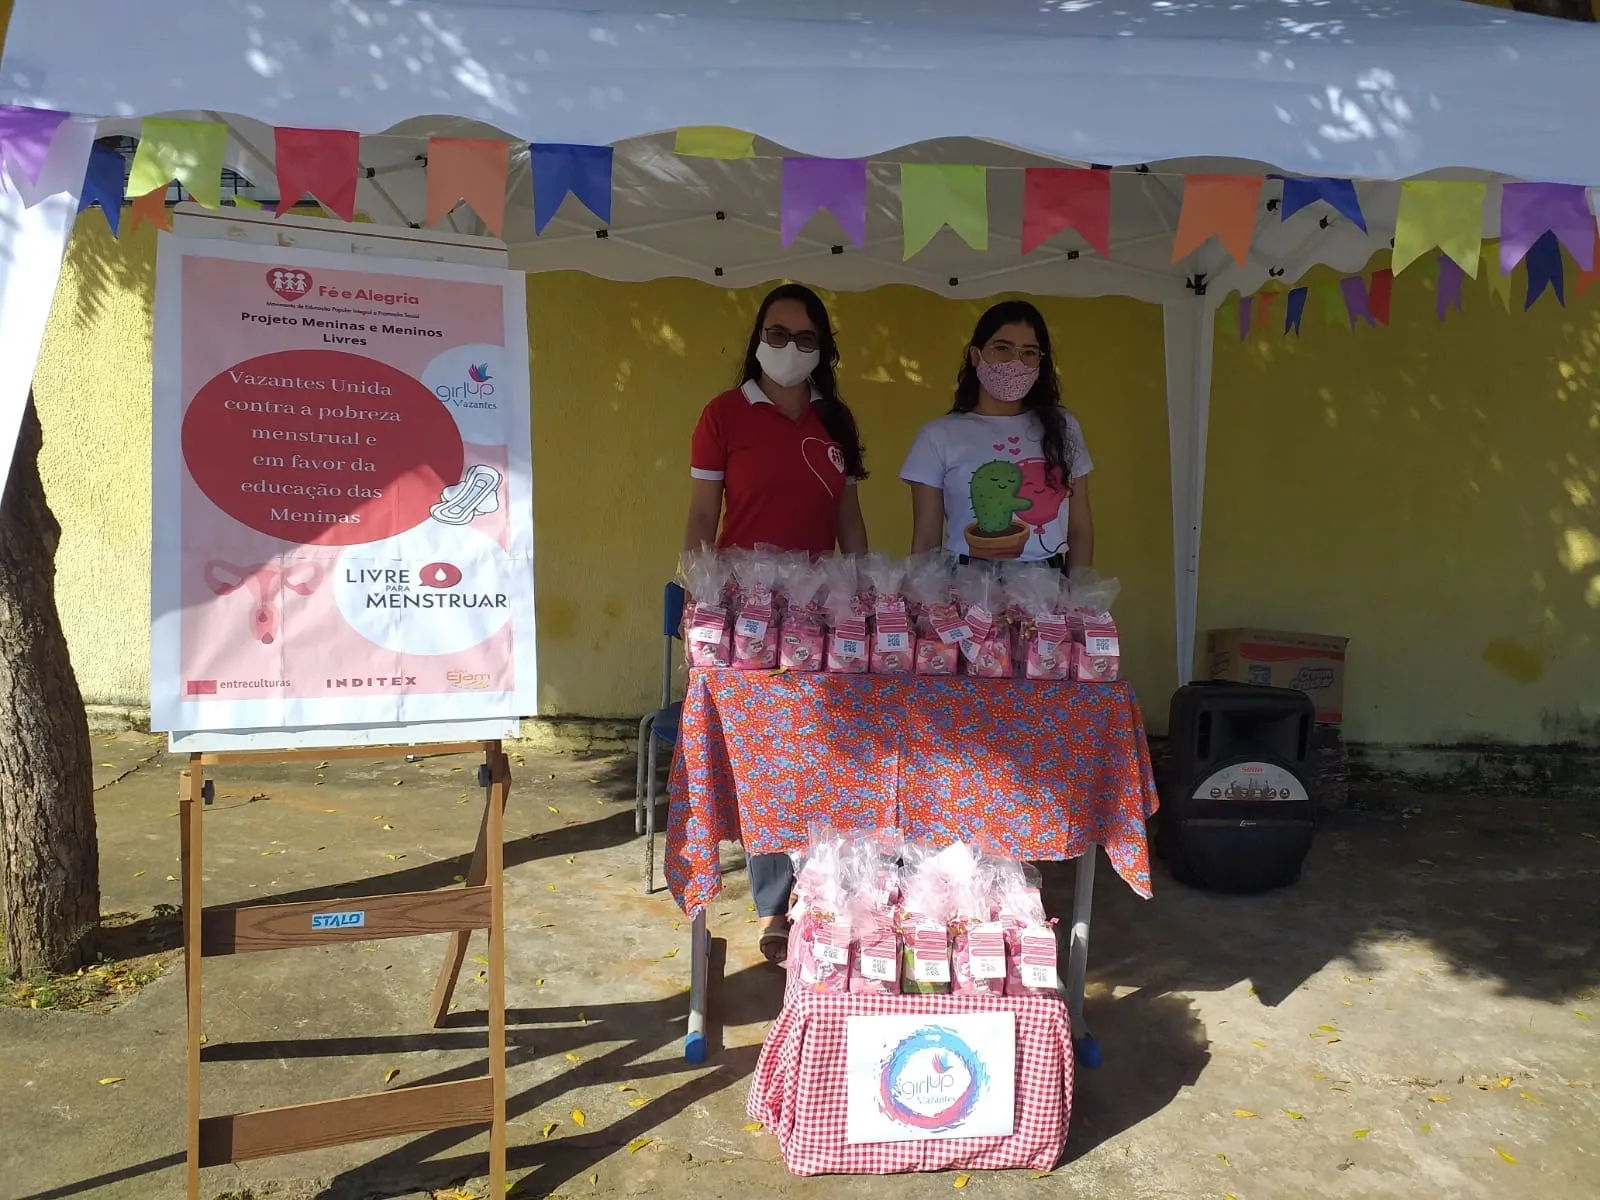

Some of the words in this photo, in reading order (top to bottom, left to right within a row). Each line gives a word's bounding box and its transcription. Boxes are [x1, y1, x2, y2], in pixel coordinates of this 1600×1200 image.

[319, 285, 339, 298] Fé
[341, 290, 353, 299] e
[354, 288, 420, 305] Alegria
[241, 312, 298, 326] Projeto
[302, 317, 365, 331] Meninas
[369, 324, 378, 333] e
[382, 324, 443, 338] Meninos
[323, 333, 367, 346] Livres
[228, 370, 326, 390] Vazantes
[331, 378, 392, 396] Unida
[224, 399, 296, 415] contra
[300, 405, 313, 416] a
[318, 405, 402, 422] pobreza
[453, 399, 497, 410] Vazantes
[252, 428, 361, 445] menstrual
[366, 435, 377, 446] e
[252, 455, 284, 467] em
[292, 454, 346, 470] favor
[350, 458, 377, 472] da
[240, 479, 341, 500] educação
[347, 484, 383, 498] das
[270, 508, 361, 524] Meninas
[346, 568, 410, 584] LIVRE
[385, 584, 411, 592] PARA
[366, 592, 508, 609] MENSTRUAR
[219, 678, 291, 689] entreculturas
[326, 676, 417, 689] INDITEX
[312, 913, 361, 927] STALO
